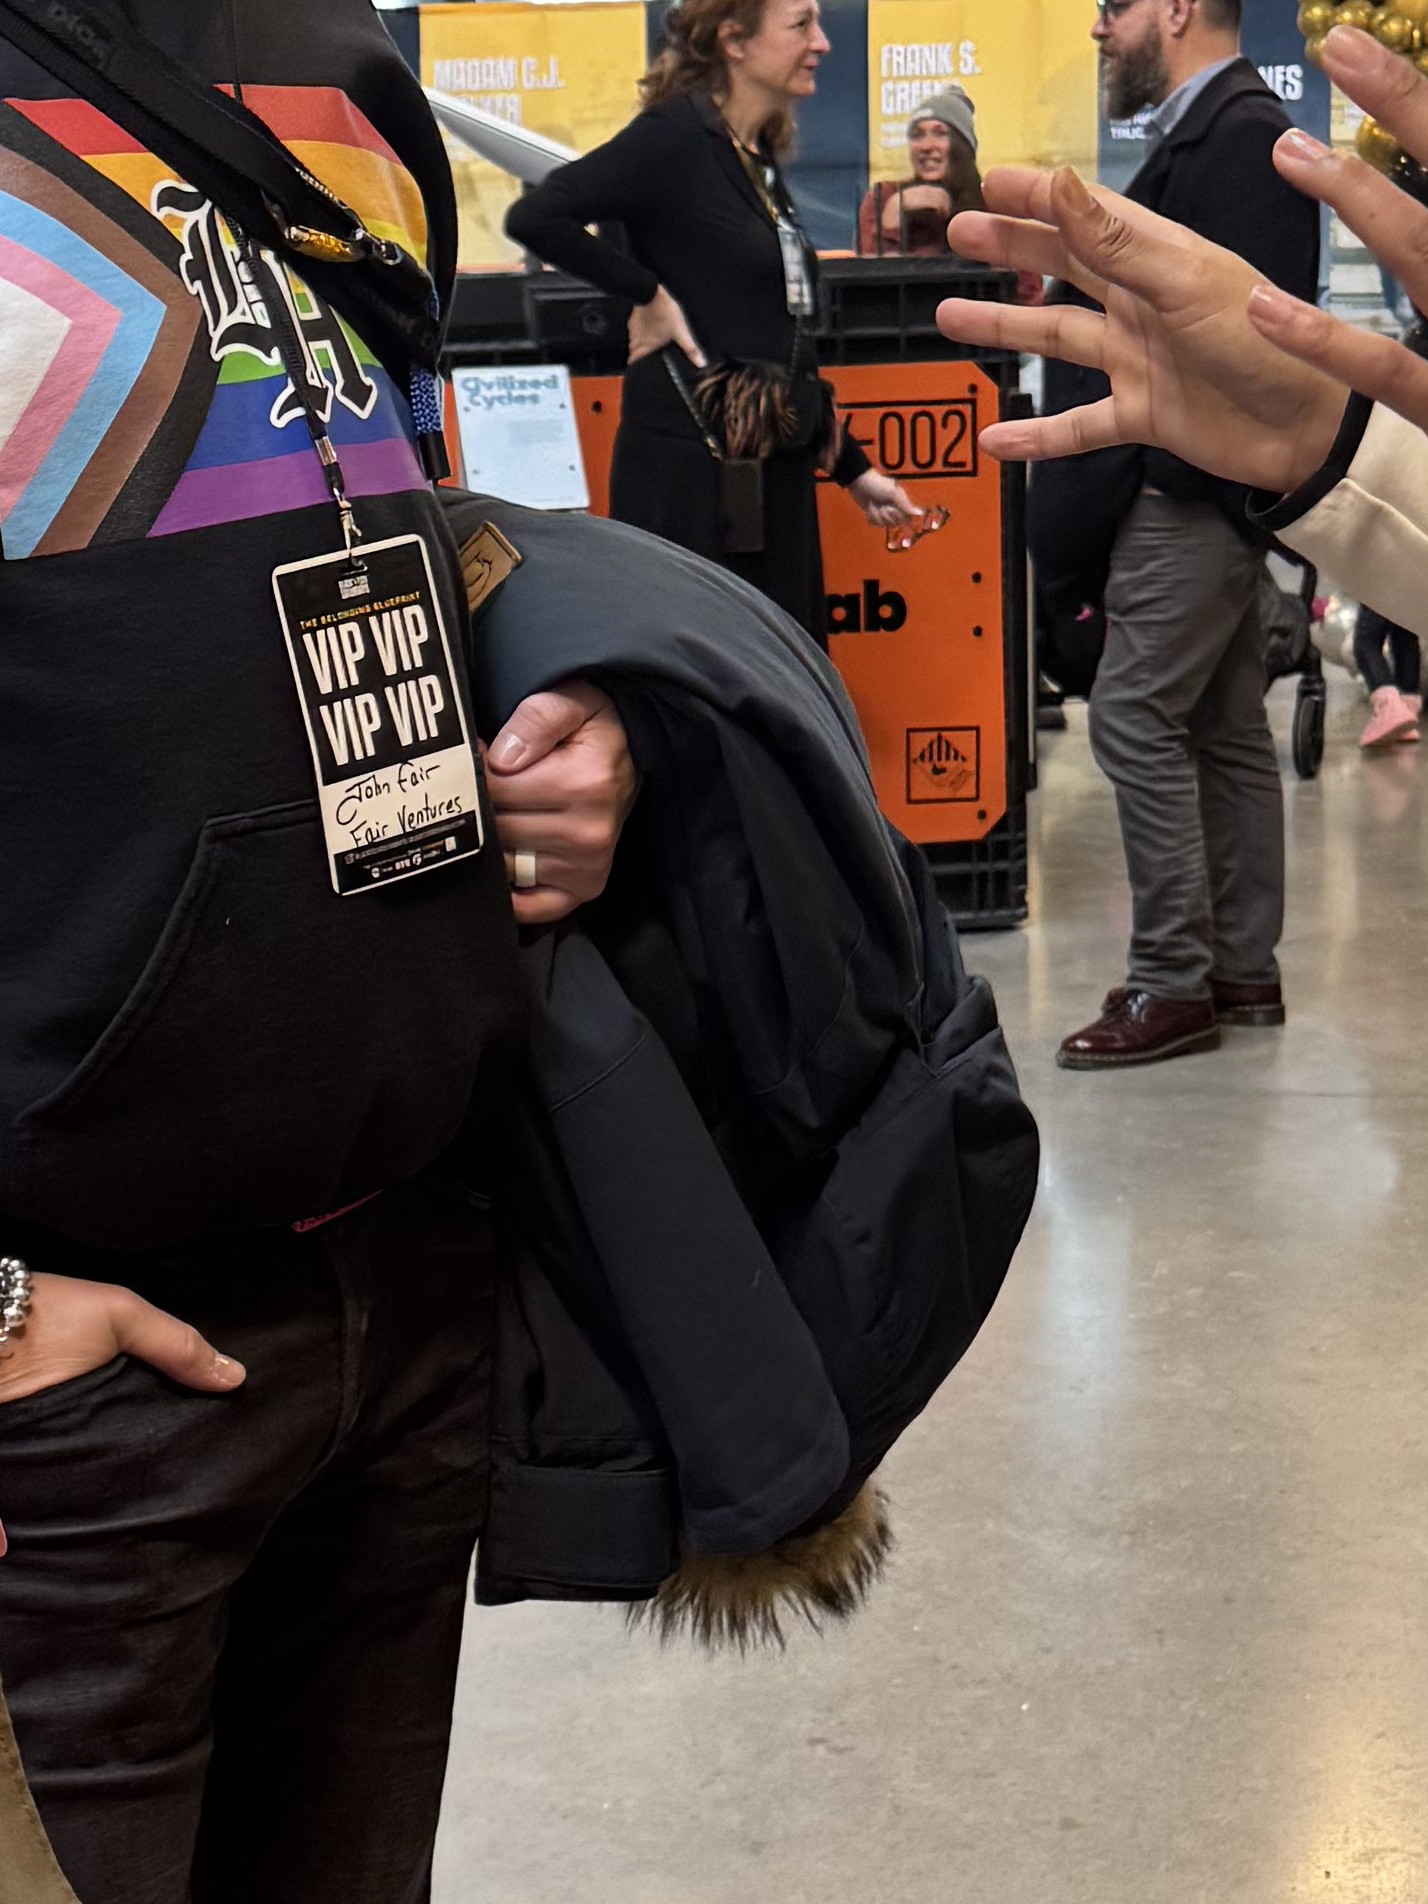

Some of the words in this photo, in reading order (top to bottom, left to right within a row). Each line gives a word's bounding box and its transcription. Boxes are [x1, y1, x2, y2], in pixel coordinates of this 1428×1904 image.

[433, 57, 516, 91] MADAM
[521, 56, 565, 88] C.J.
[880, 42, 953, 76] FRANK
[959, 39, 982, 74] S.
[462, 375, 558, 396] Civilized
[302, 621, 365, 695] VIP
[368, 604, 429, 677] VIP
[319, 692, 382, 766] VIP
[384, 674, 445, 747] VIP
[336, 773, 391, 826] John
[397, 759, 441, 794] Fair
[350, 819, 389, 848] Fair
[396, 792, 463, 834] Ventures
